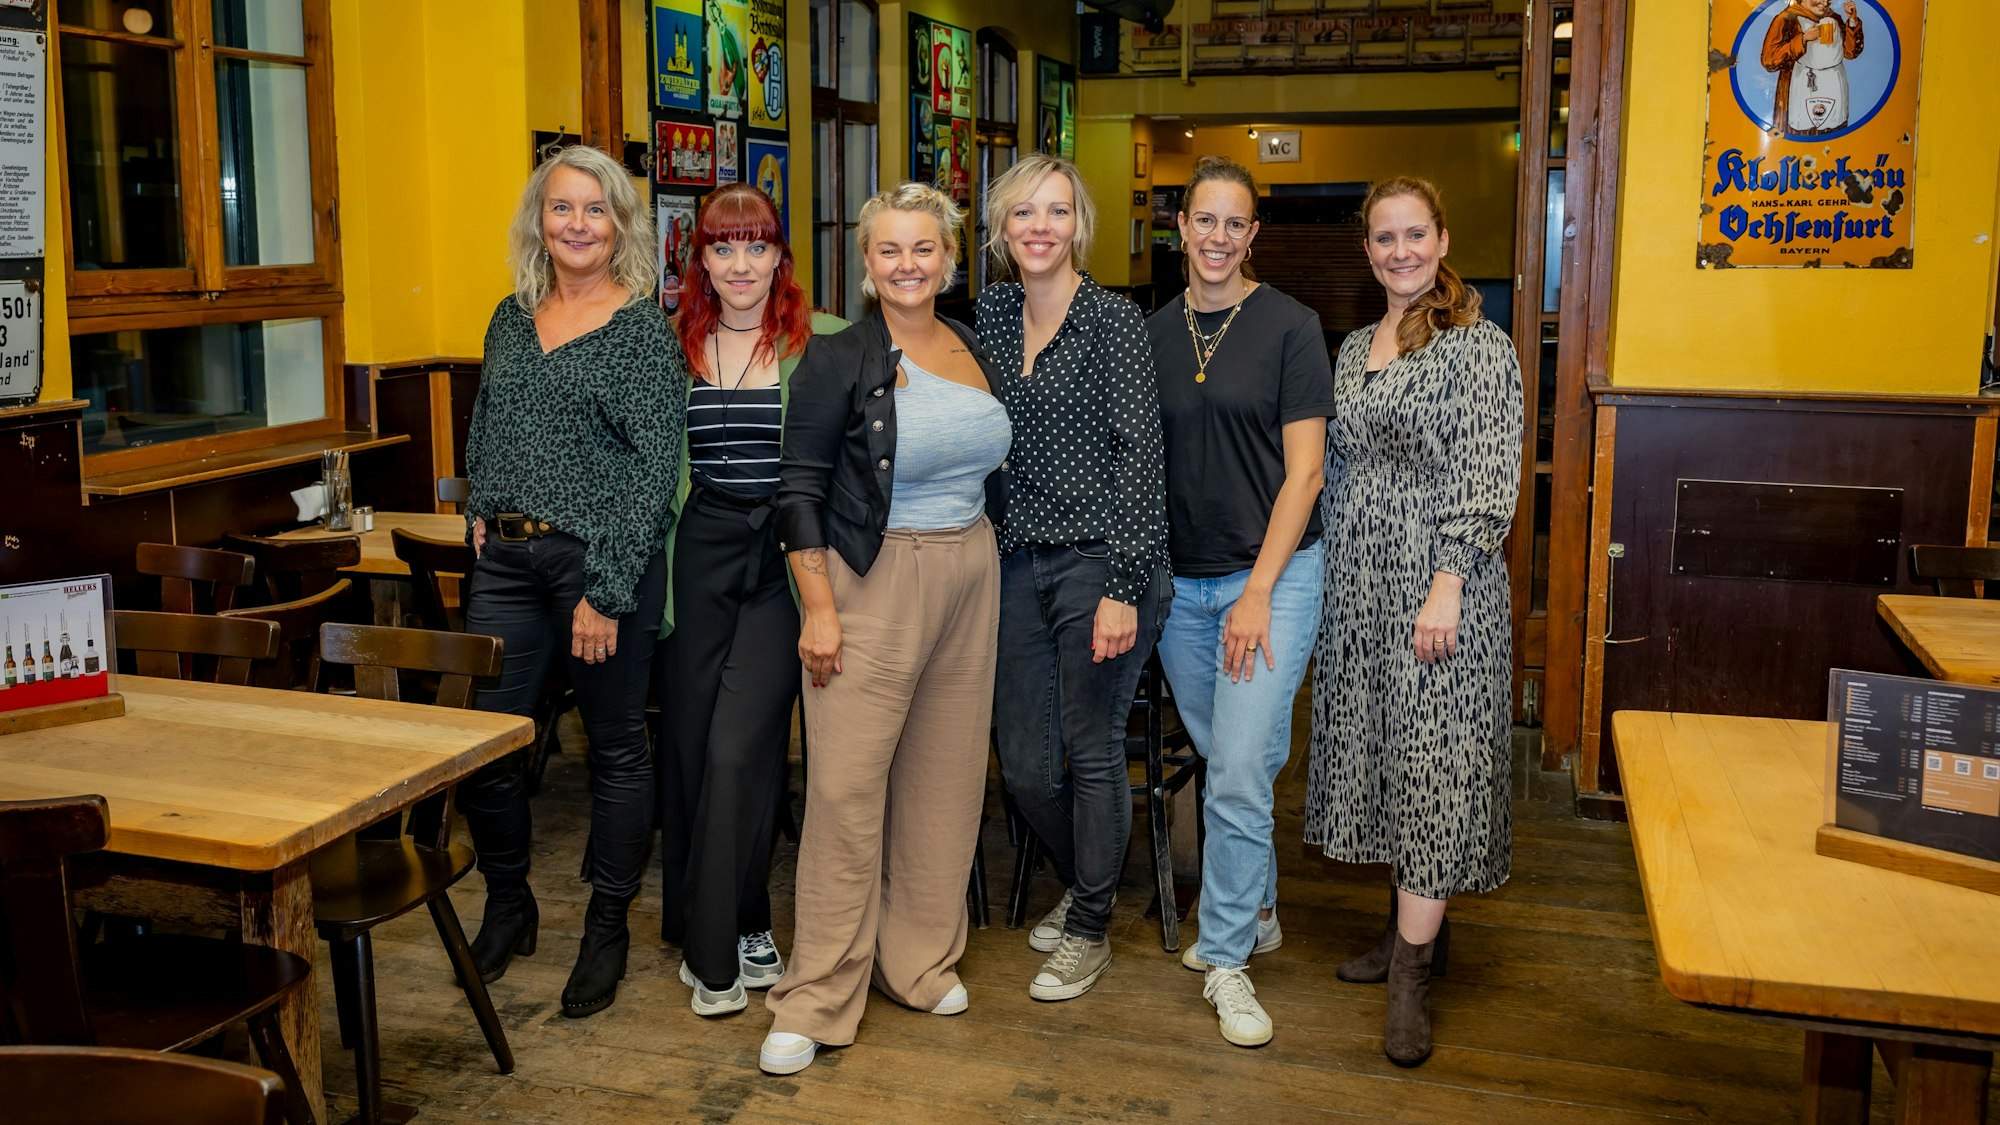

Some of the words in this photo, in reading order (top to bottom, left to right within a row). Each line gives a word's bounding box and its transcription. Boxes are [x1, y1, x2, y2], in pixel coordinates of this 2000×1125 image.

[0, 36, 20, 46] ung.
[1268, 142, 1291, 155] WC
[1751, 200, 1779, 208] HANS
[1786, 199, 1813, 207] KARL
[1719, 204, 1895, 245] Ochsenfurt
[0, 297, 32, 319] 50t
[63, 583, 98, 595] HELLERS
